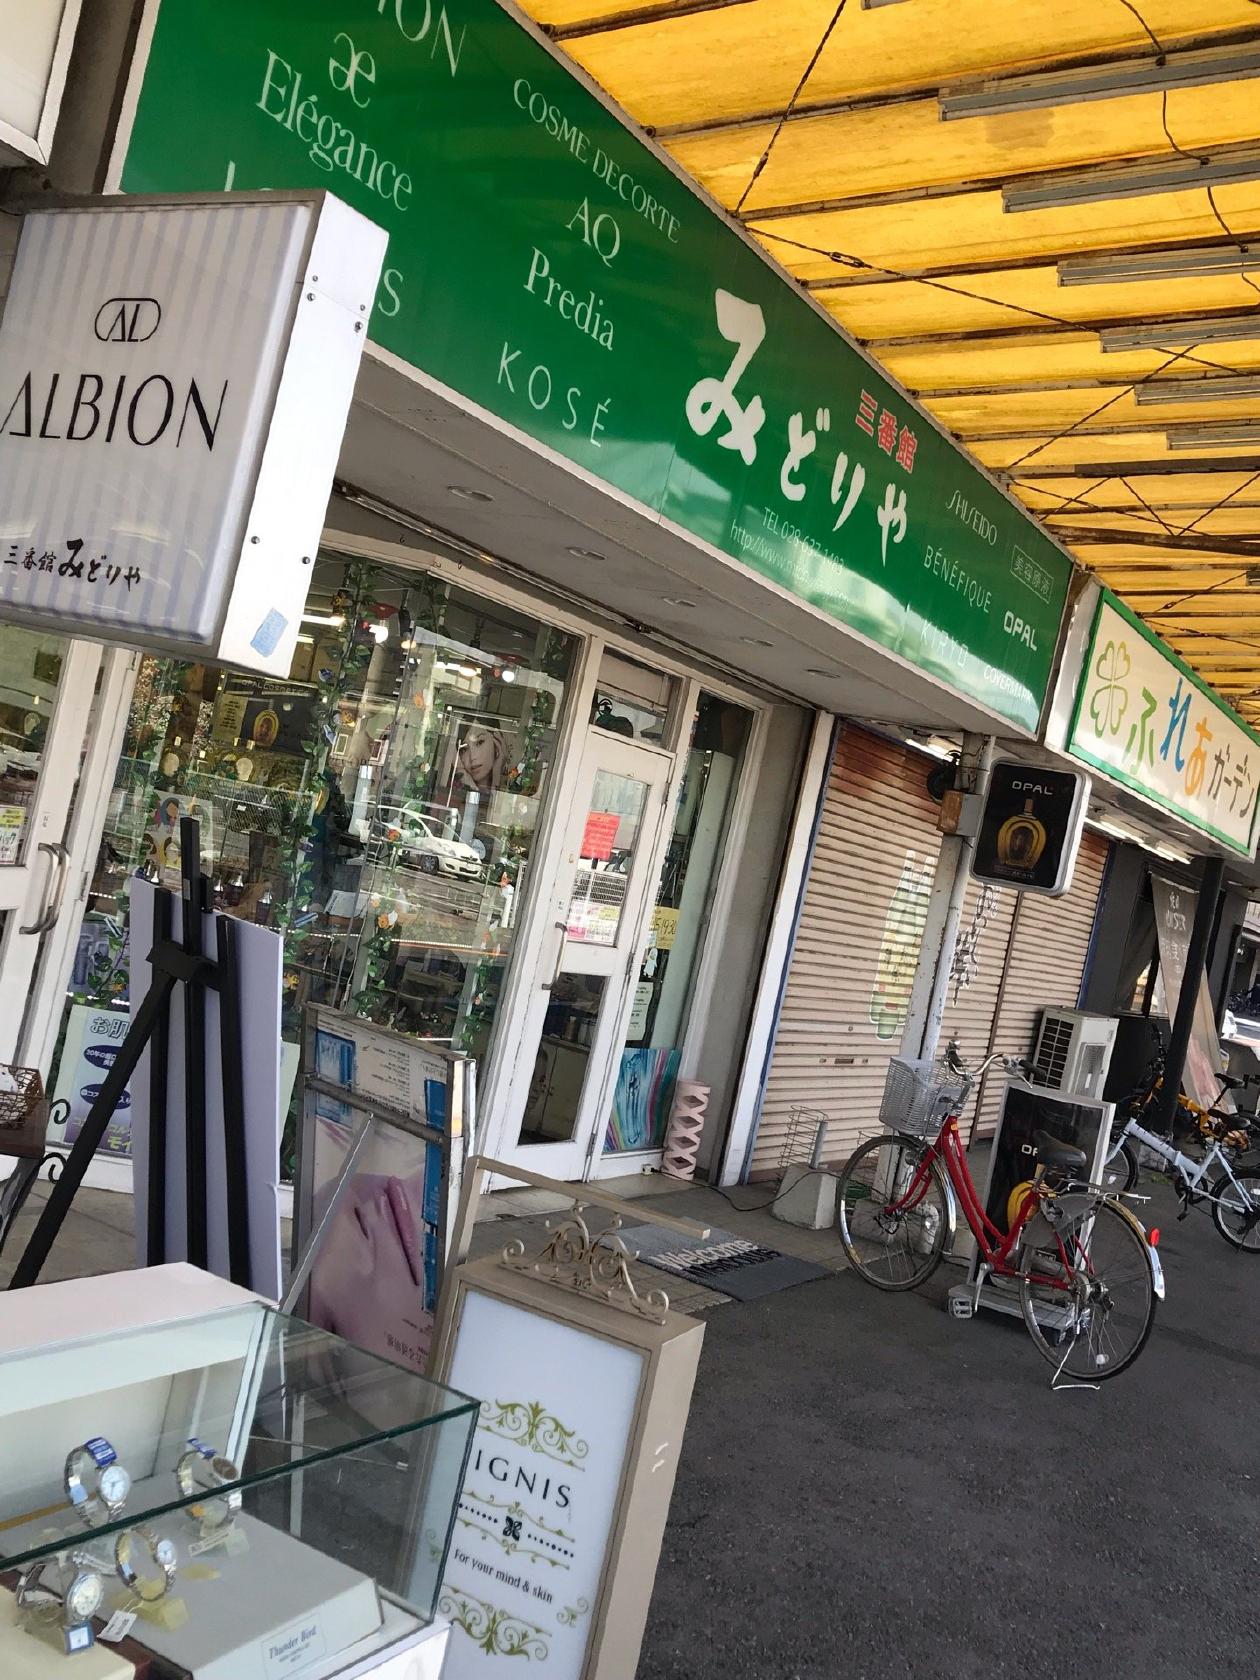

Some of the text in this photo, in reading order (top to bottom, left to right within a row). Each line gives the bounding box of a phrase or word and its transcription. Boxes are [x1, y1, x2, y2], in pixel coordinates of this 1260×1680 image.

[377, 0, 467, 78] ON
[255, 49, 413, 211] Elégance
[513, 78, 681, 243] COSME DECORTE
[565, 196, 621, 268] AQ
[523, 247, 616, 351] Predia
[0, 370, 229, 452] ALBION
[496, 341, 610, 448] KOSÉ
[685, 287, 908, 568] みどりや
[854, 388, 919, 474] 三番館
[762, 507, 779, 536] TEL
[945, 489, 999, 547] SHISEIDO
[923, 545, 993, 614] BÉNÉFIQUE
[920, 617, 969, 669] KIRYO
[1003, 610, 1038, 652] OPAL
[1011, 780, 1053, 796] OPAL
[647, 1239, 759, 1270] Welcome
[474, 1449, 572, 1509] IGNIS
[454, 1548, 553, 1604] For your mind & skin
